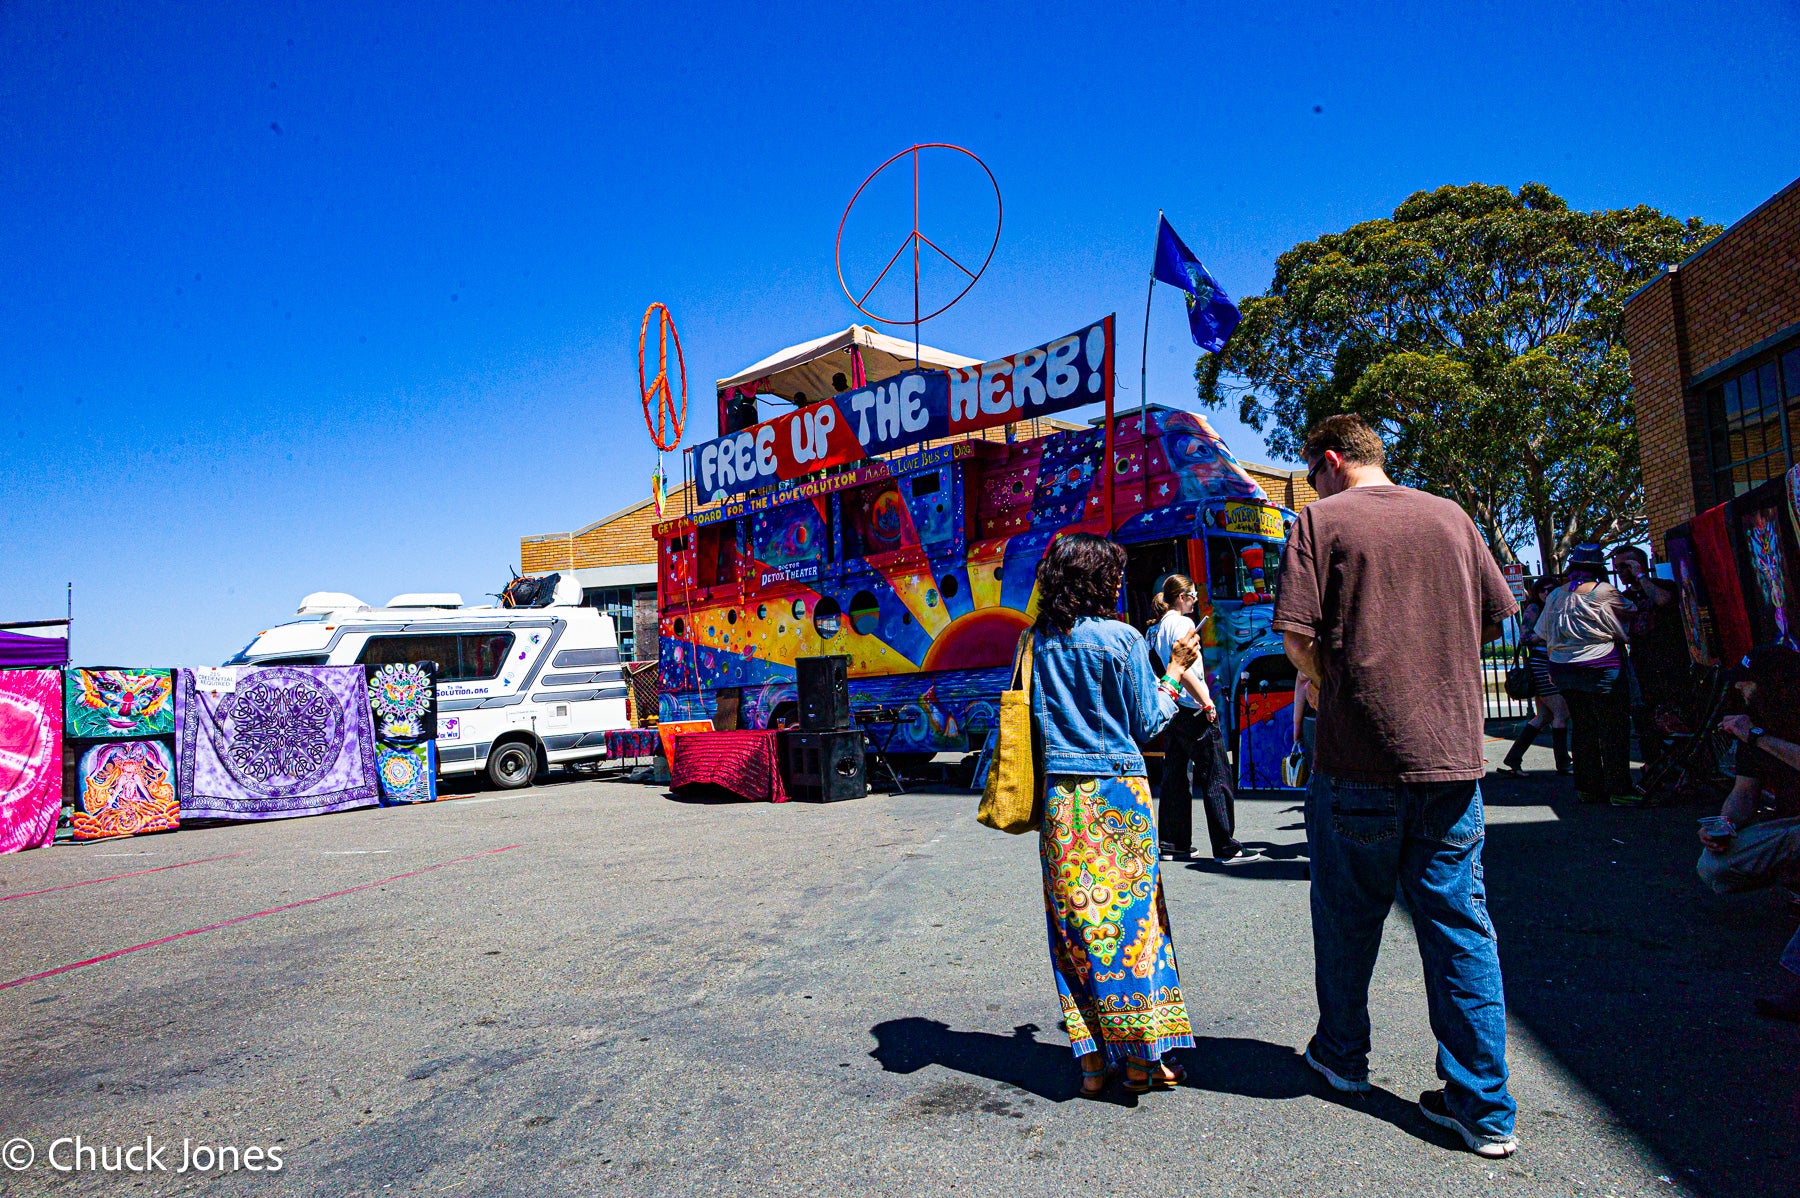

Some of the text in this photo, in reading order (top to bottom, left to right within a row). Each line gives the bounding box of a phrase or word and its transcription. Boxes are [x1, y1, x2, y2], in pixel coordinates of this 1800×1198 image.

[702, 325, 1105, 491] FREE UP THE HERB!
[898, 458, 920, 473] LOVE
[922, 451, 940, 466] BUS
[658, 472, 857, 535] GET ON BOARD FOR THE LOVEVOLUTION
[779, 562, 800, 571] DOCTOR
